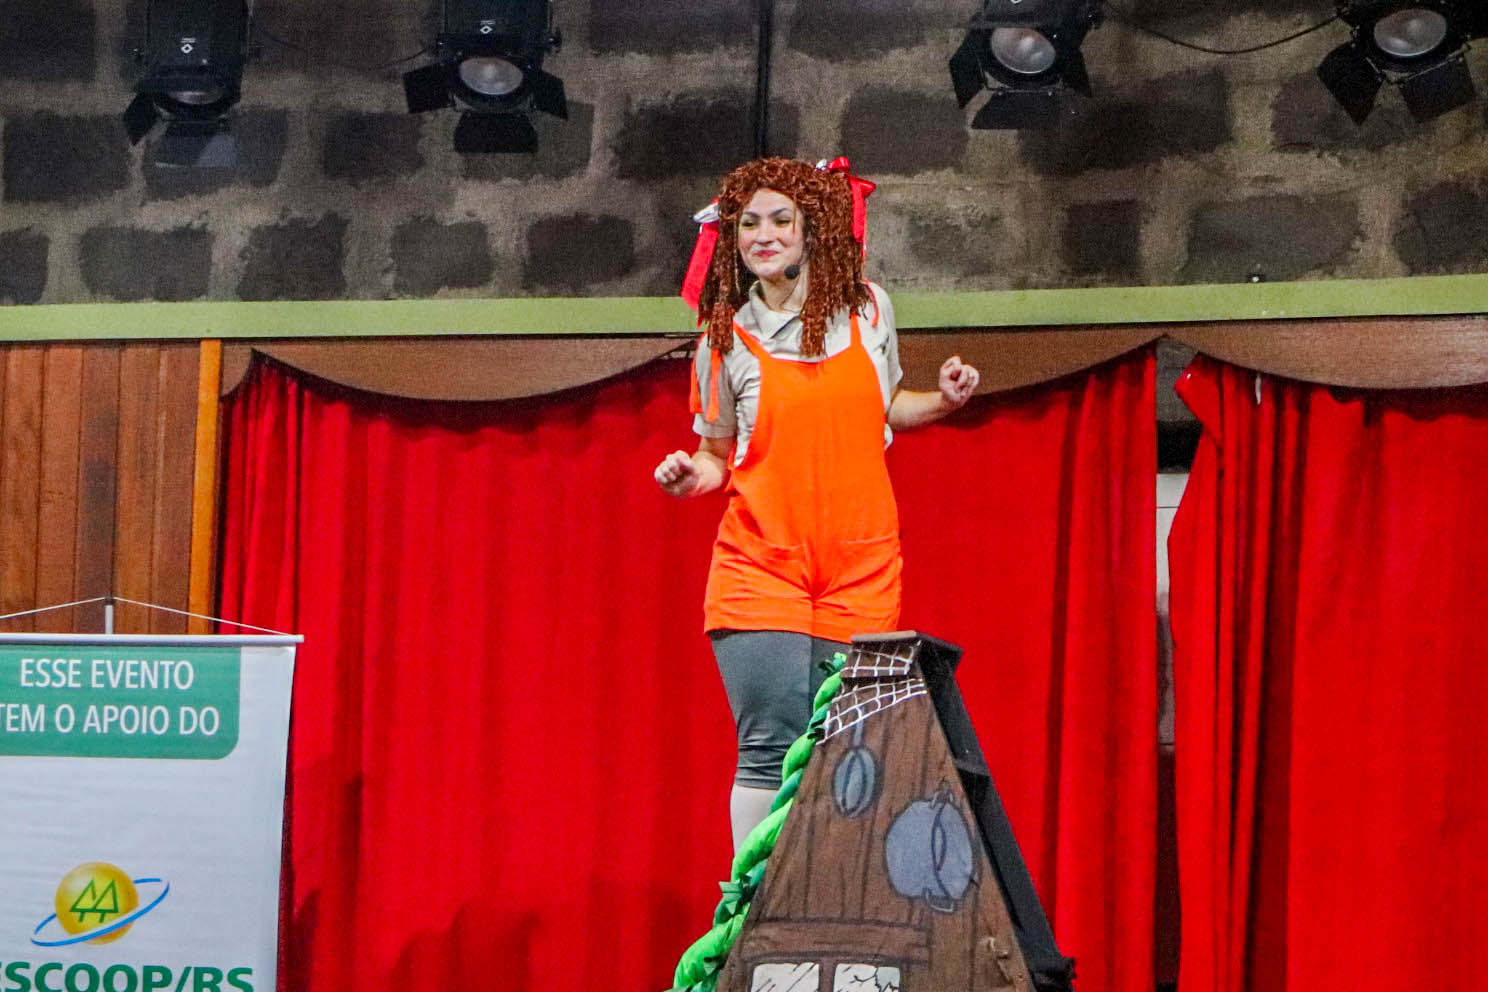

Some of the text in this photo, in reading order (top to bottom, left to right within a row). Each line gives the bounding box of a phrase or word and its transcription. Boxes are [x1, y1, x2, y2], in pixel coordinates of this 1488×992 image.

[20, 658, 194, 690] ESSE EVENTO
[55, 703, 75, 733] O
[82, 705, 170, 735] APOIO
[179, 706, 220, 736] DO
